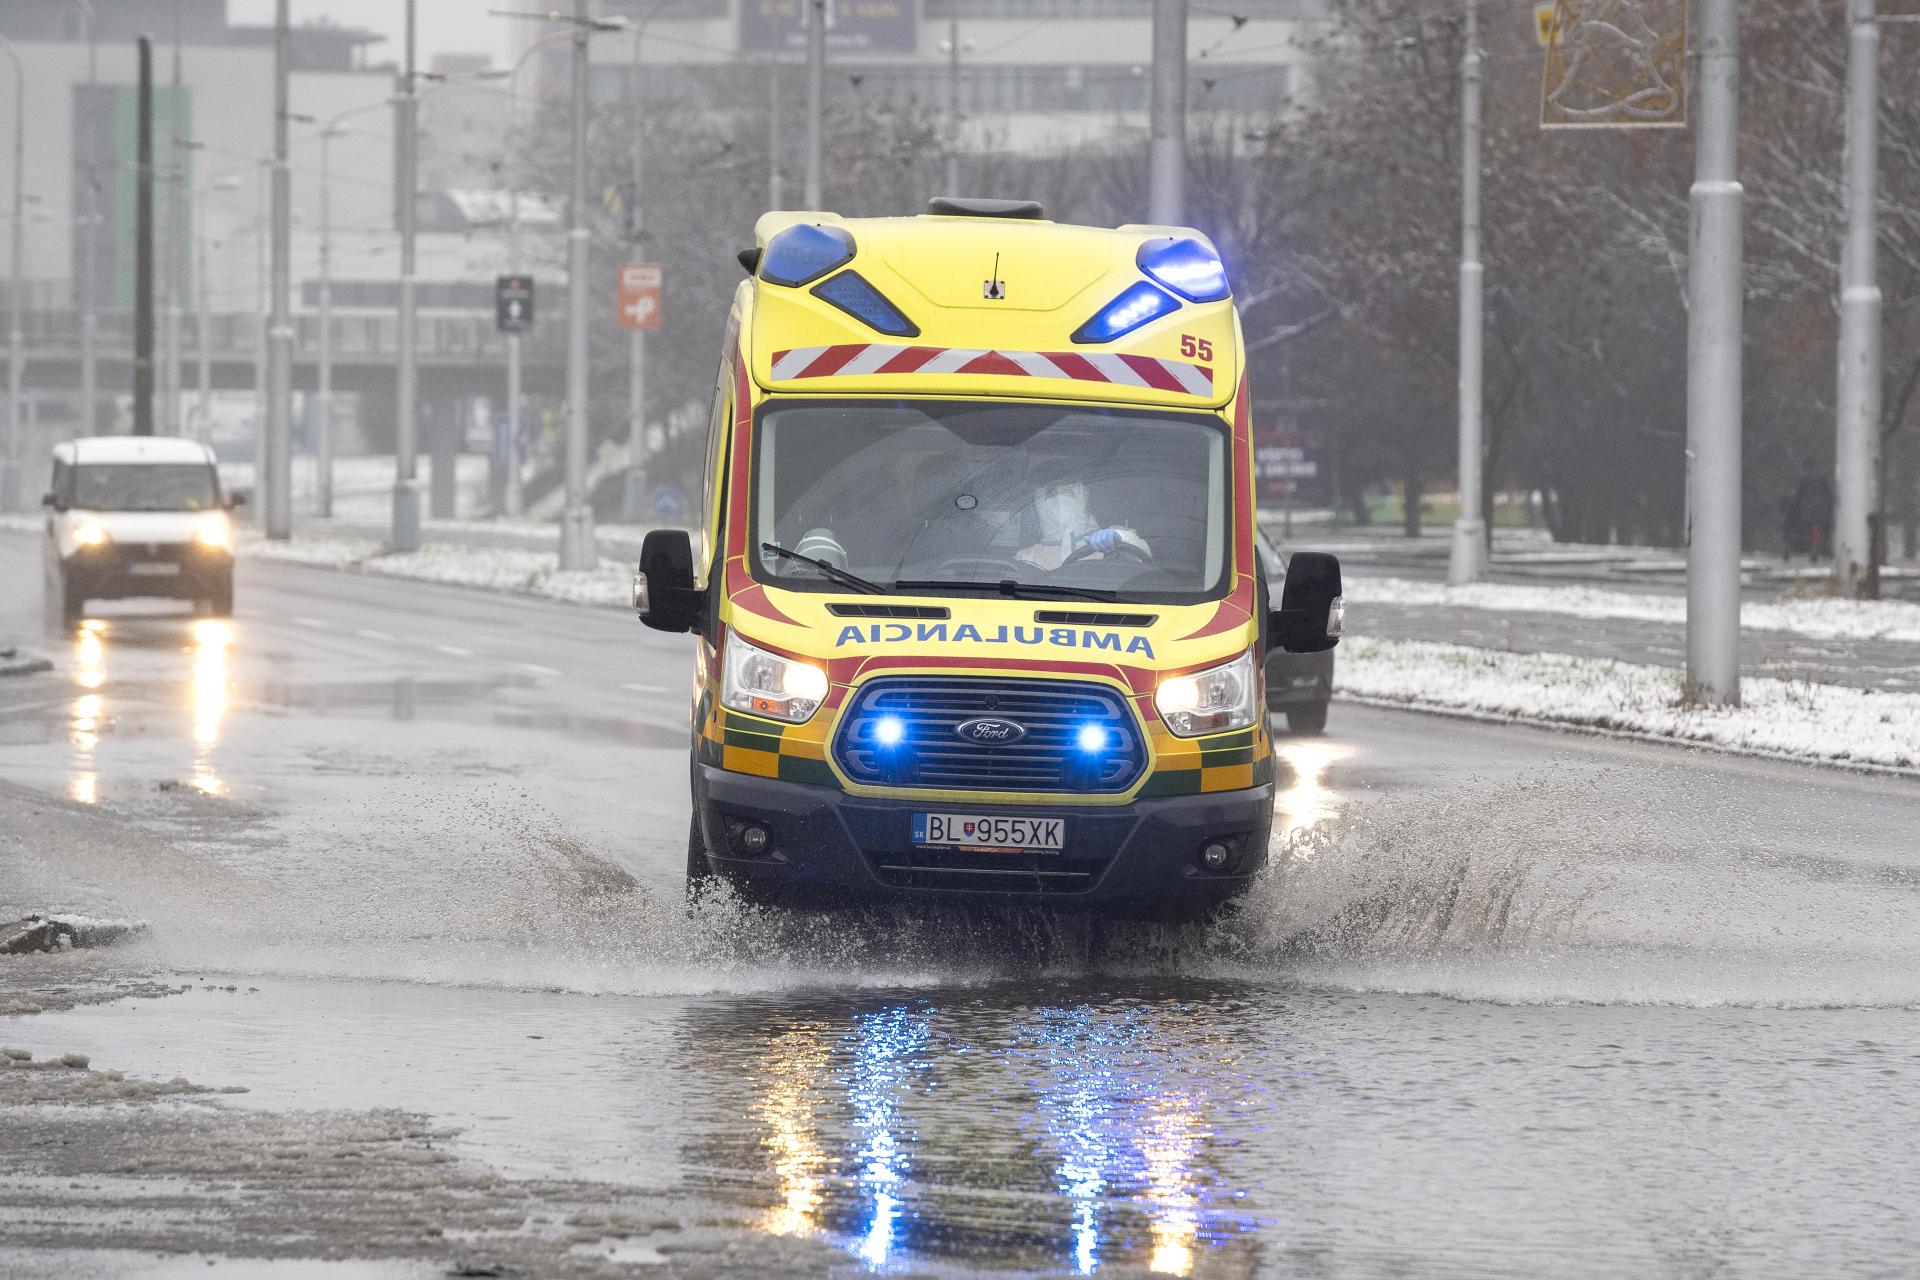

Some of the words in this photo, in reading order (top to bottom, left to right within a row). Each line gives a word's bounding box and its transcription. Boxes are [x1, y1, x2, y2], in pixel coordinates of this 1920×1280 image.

[1180, 334, 1213, 362] 55
[972, 722, 1009, 739] Ford
[929, 815, 961, 841] BL
[977, 818, 1060, 846] 955XK
